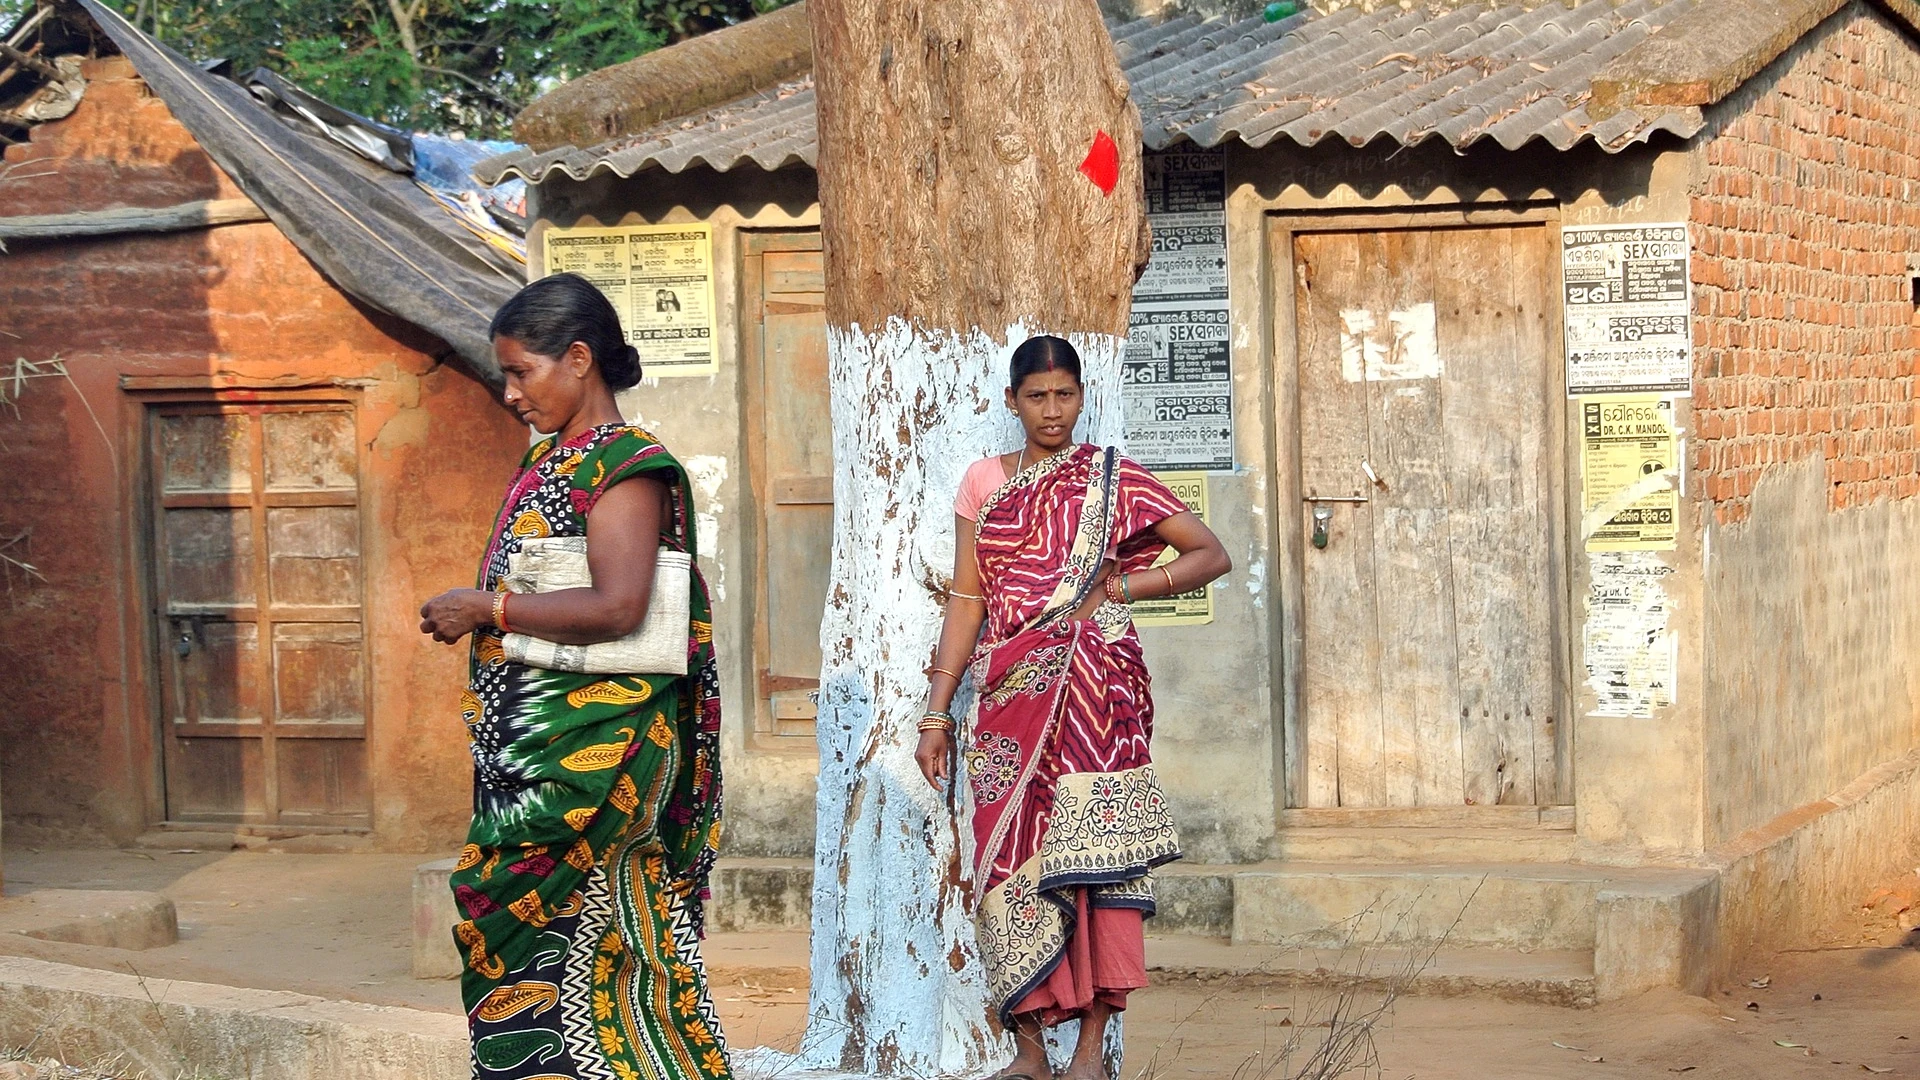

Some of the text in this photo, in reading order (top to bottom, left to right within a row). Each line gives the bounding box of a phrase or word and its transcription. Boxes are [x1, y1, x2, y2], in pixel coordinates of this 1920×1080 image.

[1164, 156, 1189, 170] SEX
[1576, 232, 1601, 243] 100%
[1624, 244, 1649, 259] SEX
[1569, 281, 1609, 304] ଅର୍ଶ
[1129, 313, 1149, 324] 00%
[1609, 317, 1683, 328] ଗୋପନରେ
[1170, 326, 1194, 341] SEX
[1155, 397, 1227, 407] ଗୋପନରେ
[1155, 406, 1186, 421] ମଦ
[1586, 405, 1600, 434] SEX
[1604, 404, 1658, 421] ଯୌନରୋ
[1604, 426, 1616, 435] DR.
